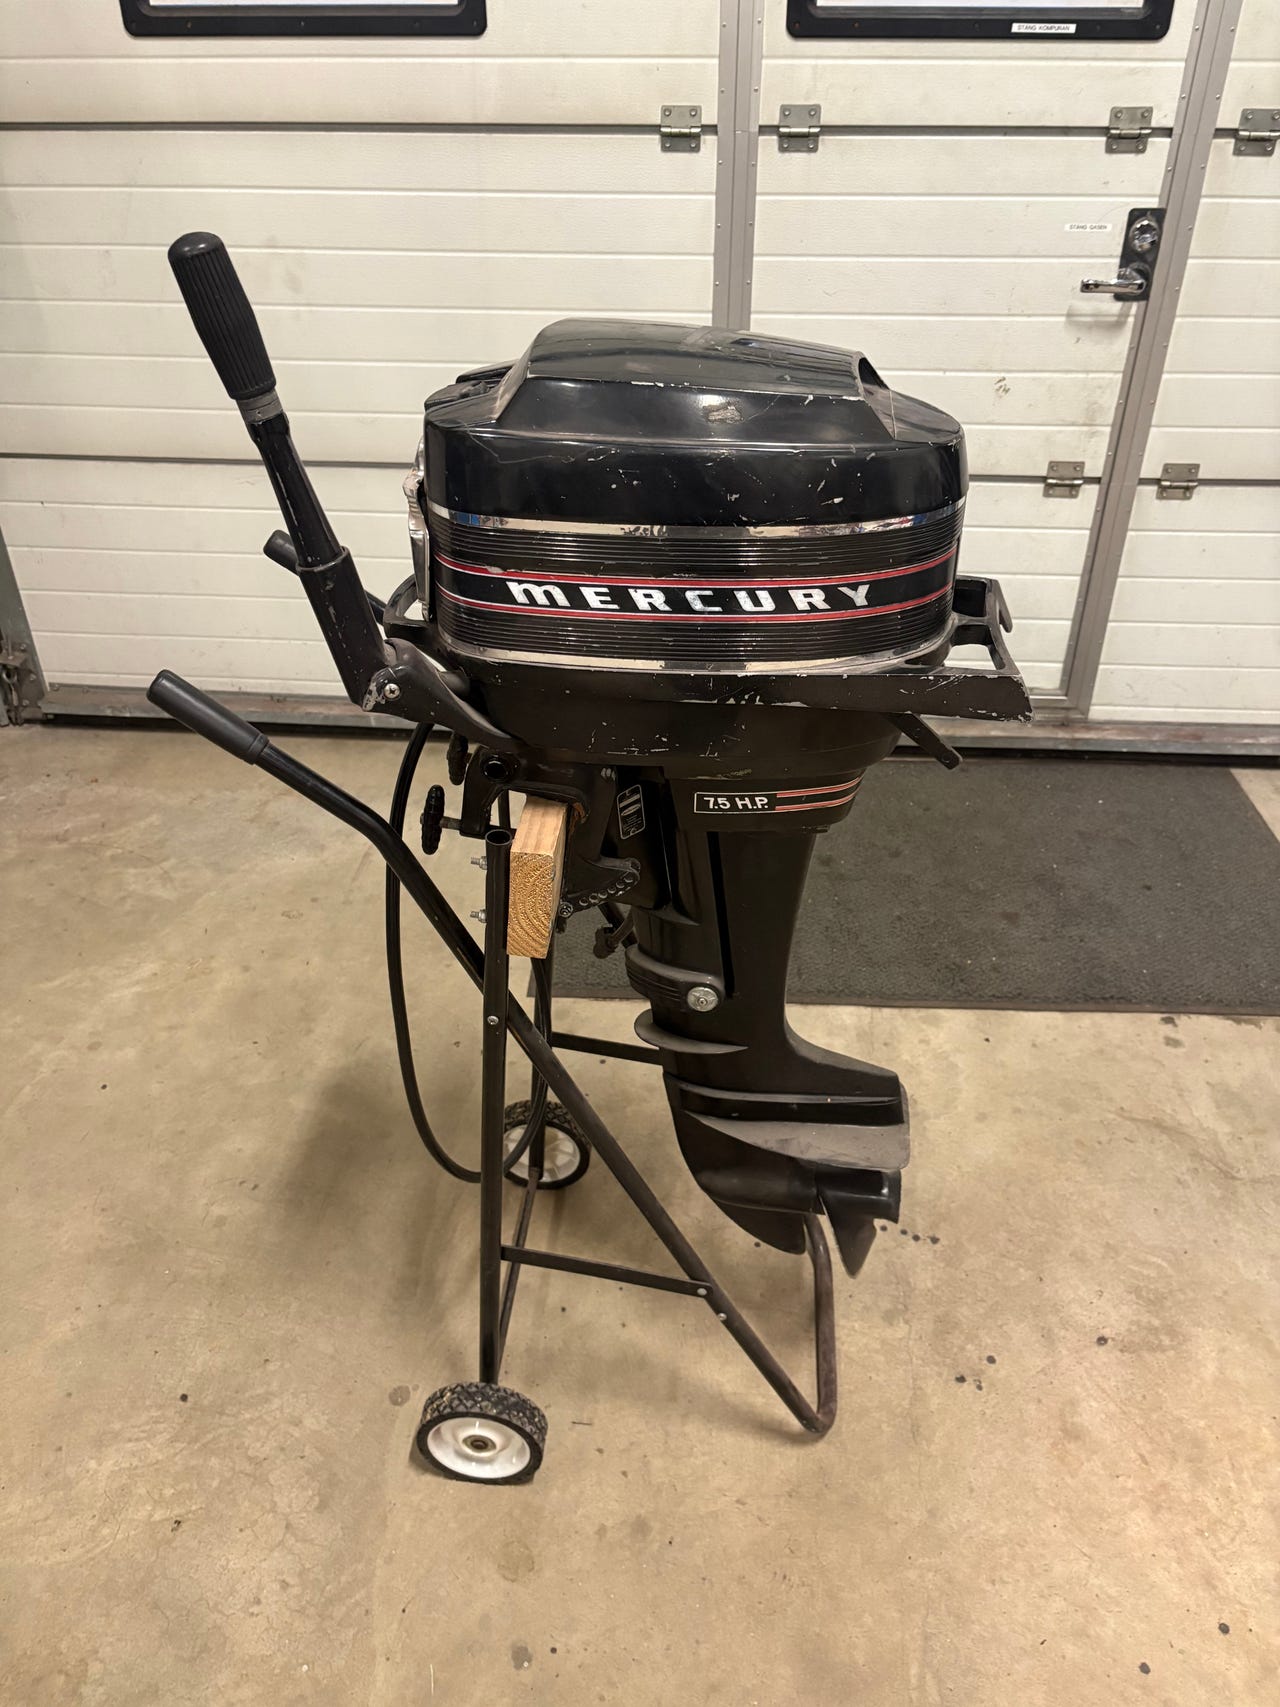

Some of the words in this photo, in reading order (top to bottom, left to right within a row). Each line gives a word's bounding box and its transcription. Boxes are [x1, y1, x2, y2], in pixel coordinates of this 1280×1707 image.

[505, 580, 871, 613] MERCURY
[703, 796, 731, 810] 7.5
[735, 796, 769, 810] H.P.
